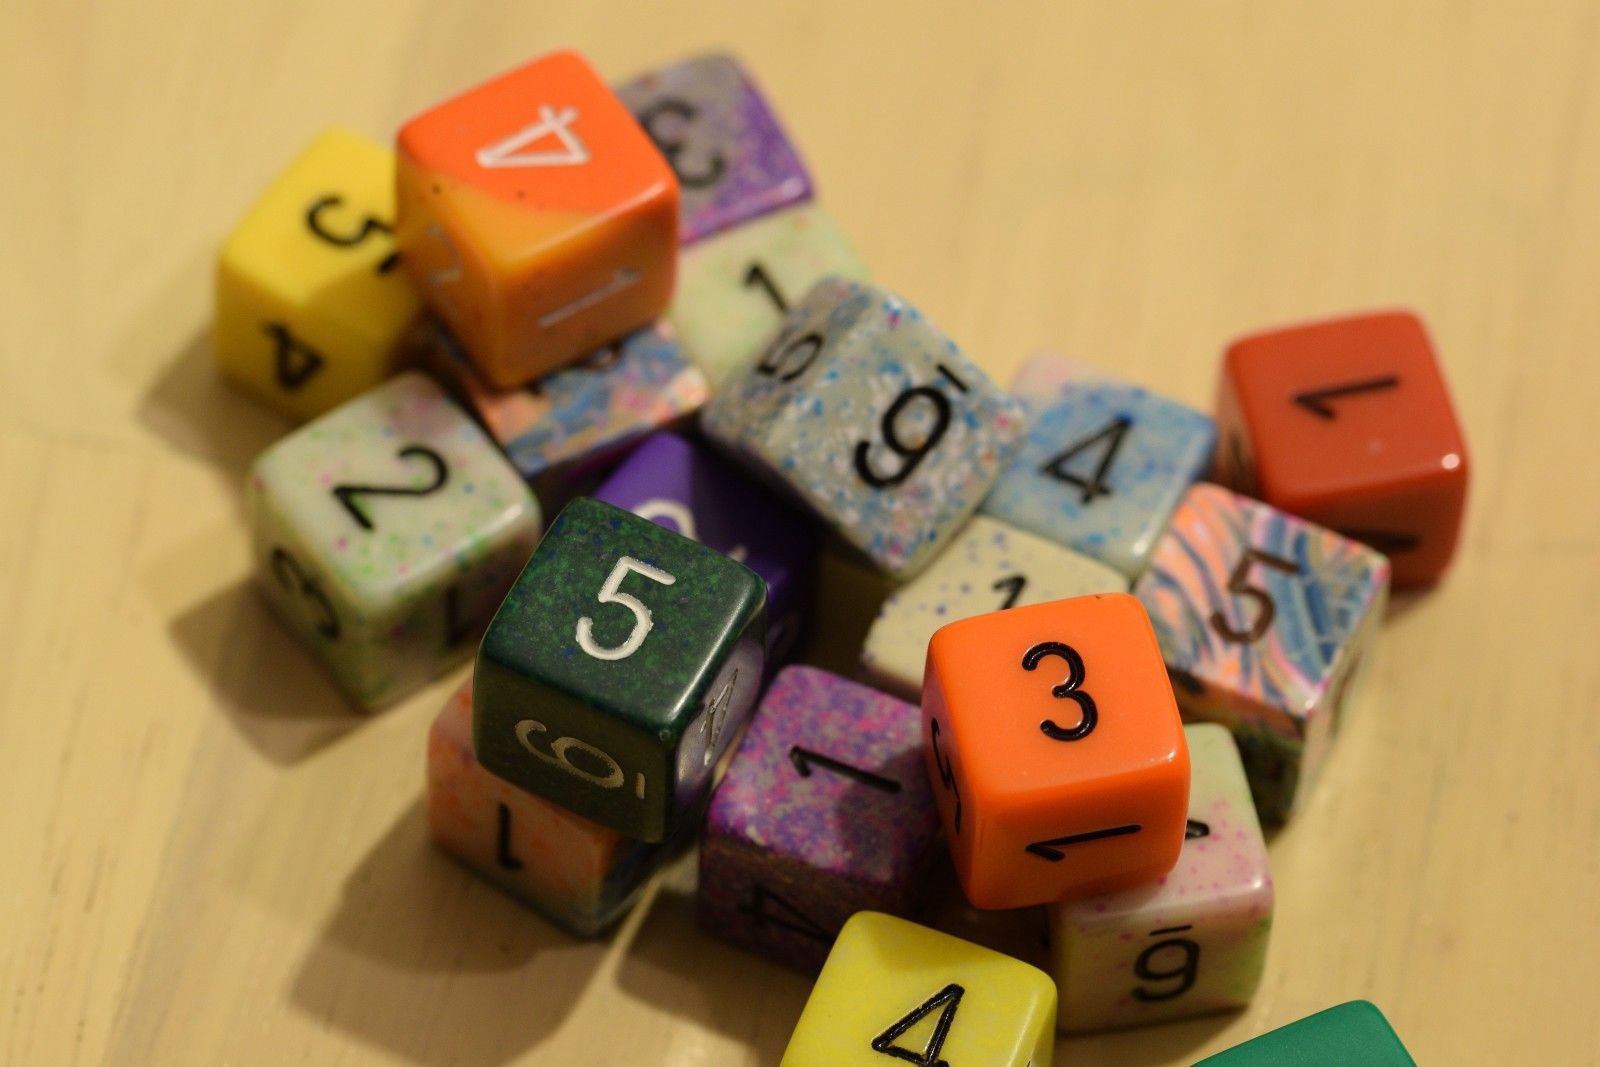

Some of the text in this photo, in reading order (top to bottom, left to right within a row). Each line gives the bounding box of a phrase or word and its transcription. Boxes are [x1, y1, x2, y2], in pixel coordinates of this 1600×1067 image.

[475, 106, 589, 168] 4
[740, 264, 790, 314] 1
[1288, 374, 1400, 422] 1
[333, 446, 450, 532] 2
[1036, 412, 1135, 506] 4
[575, 556, 677, 661] 5
[1208, 546, 1305, 646] 5
[1020, 641, 1099, 742] 3
[789, 745, 901, 794] 1
[497, 800, 524, 872] 1
[1024, 823, 1142, 862] 1
[871, 982, 965, 1067] 4
